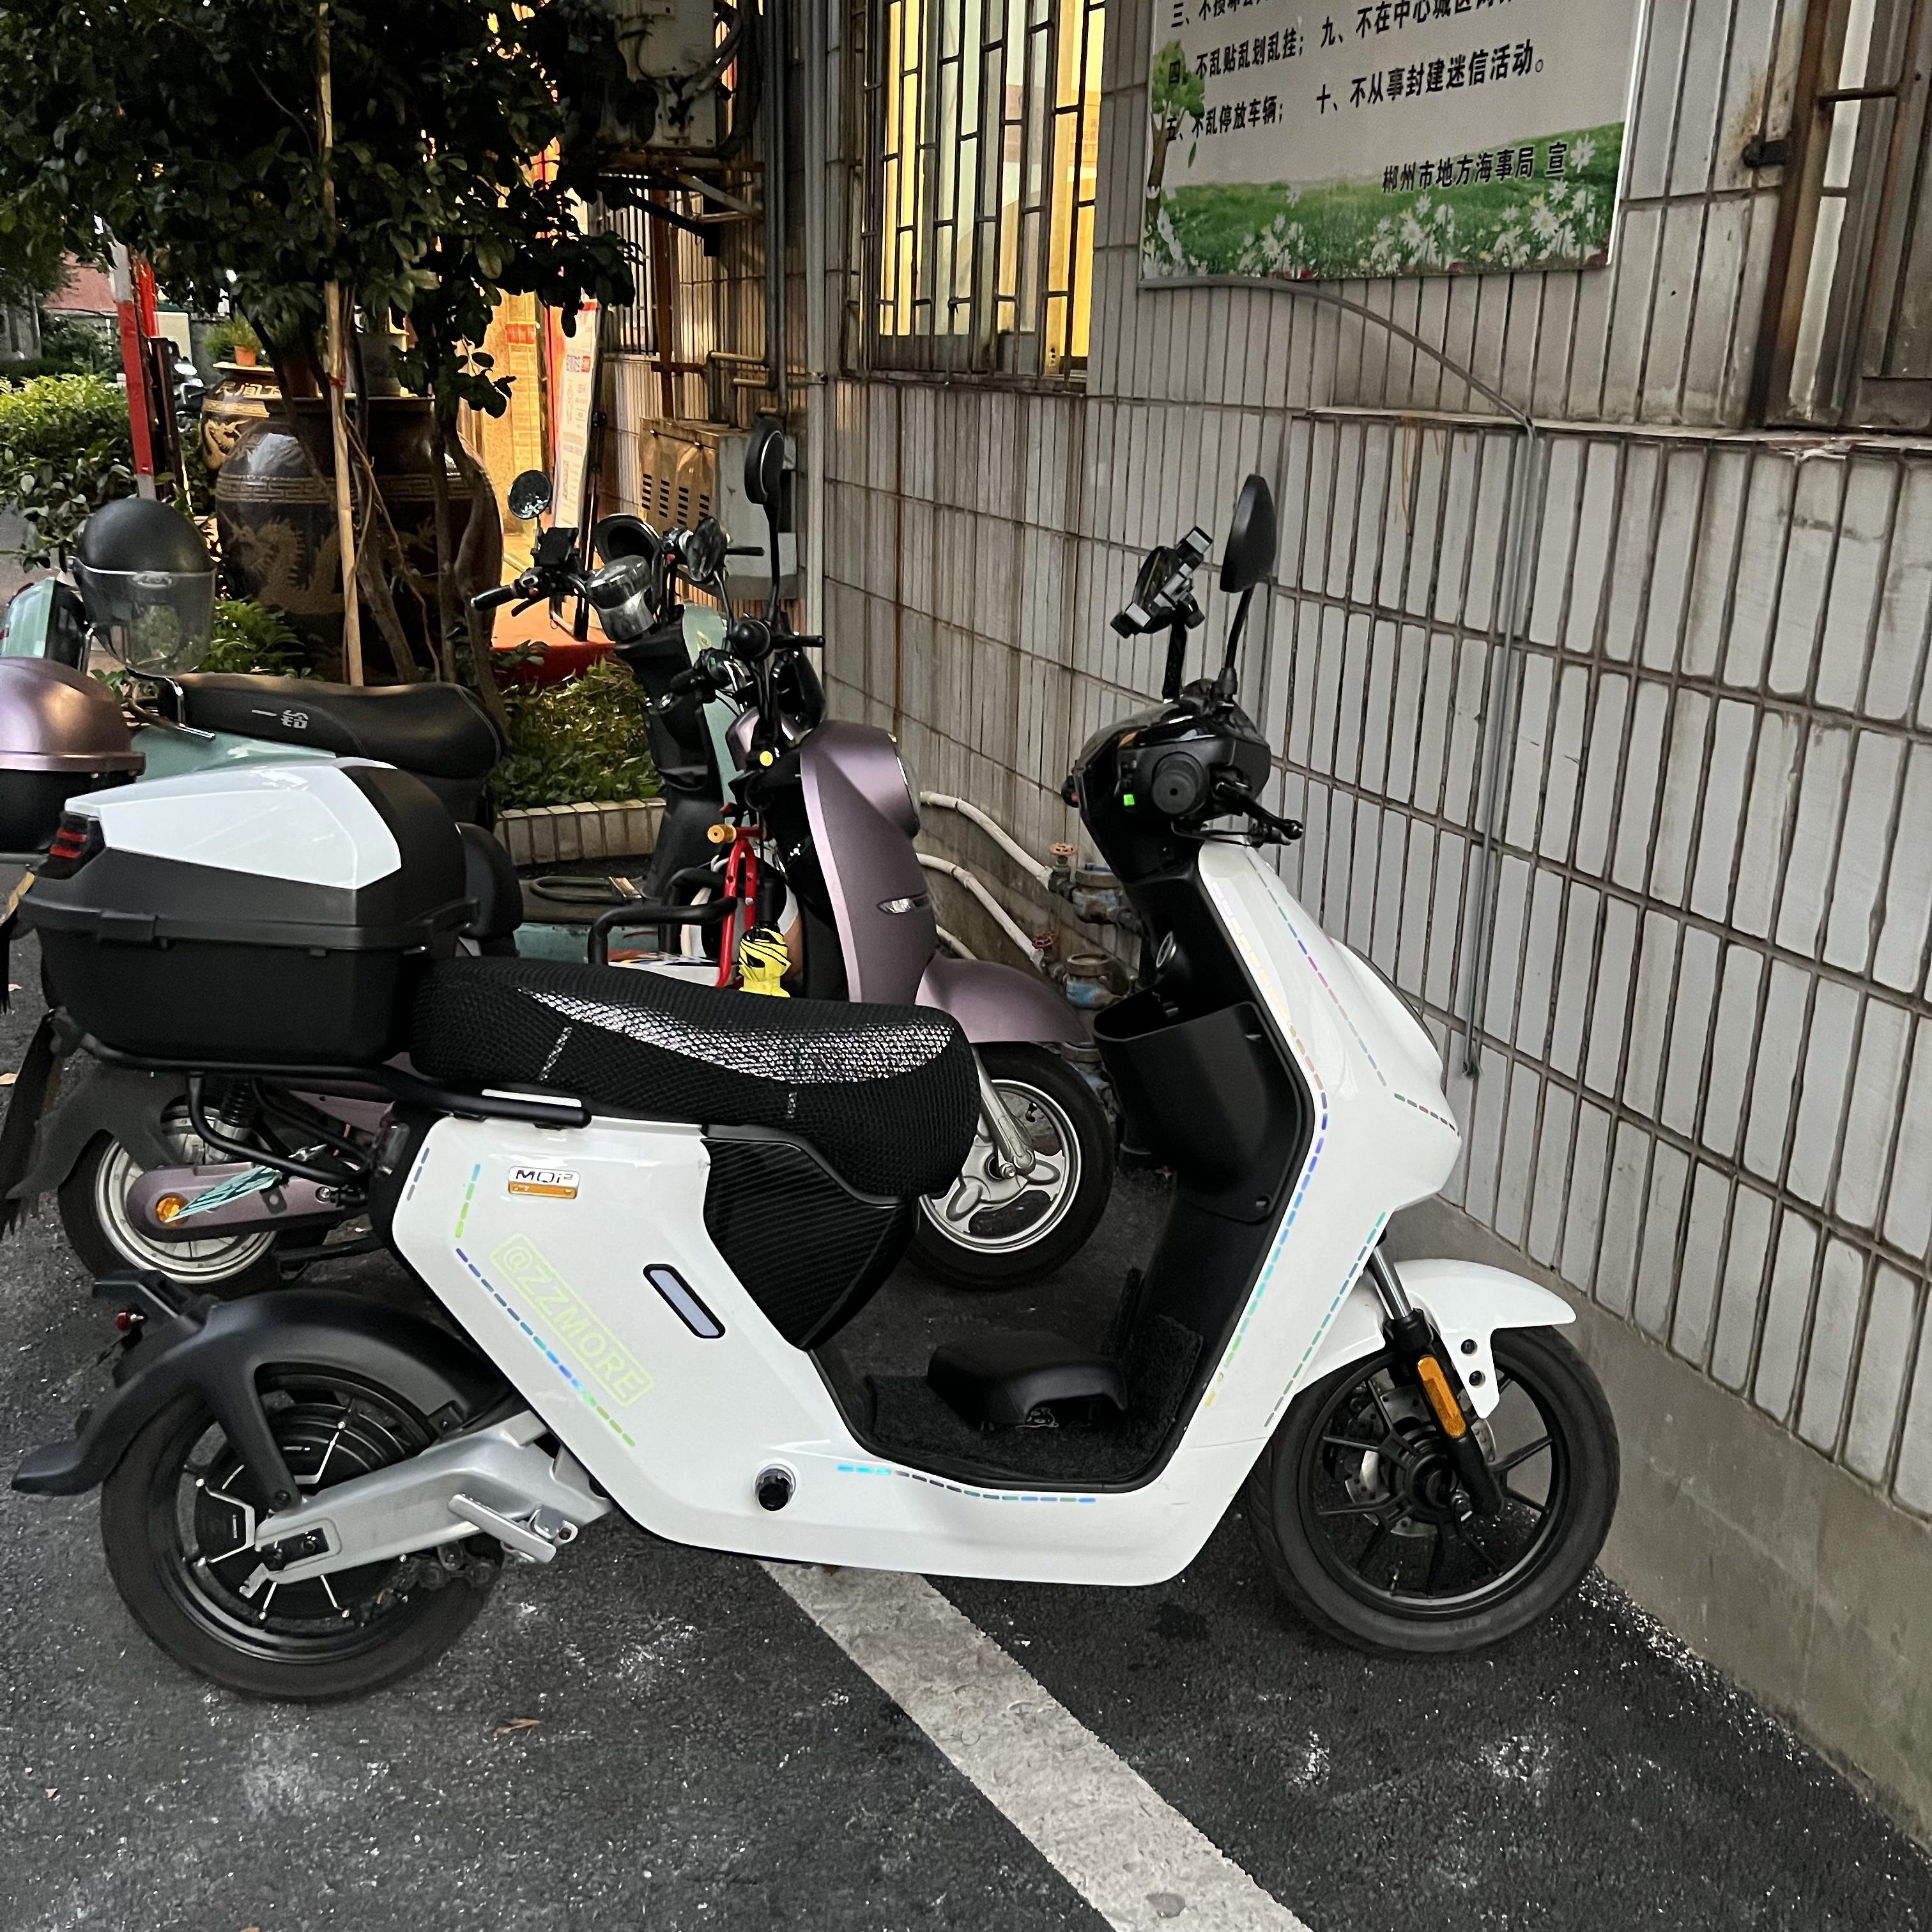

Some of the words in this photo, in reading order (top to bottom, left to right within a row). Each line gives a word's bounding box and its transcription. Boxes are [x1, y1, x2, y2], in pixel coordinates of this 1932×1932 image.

[1321, 0, 1512, 48] 九、不在中心城
[1316, 39, 1544, 114] 十、不从事封建迷信活动。
[1383, 145, 1534, 194] 郴州市地方海事局
[1546, 142, 1567, 174] 宣
[503, 1246, 644, 1399] @ZZMORE
